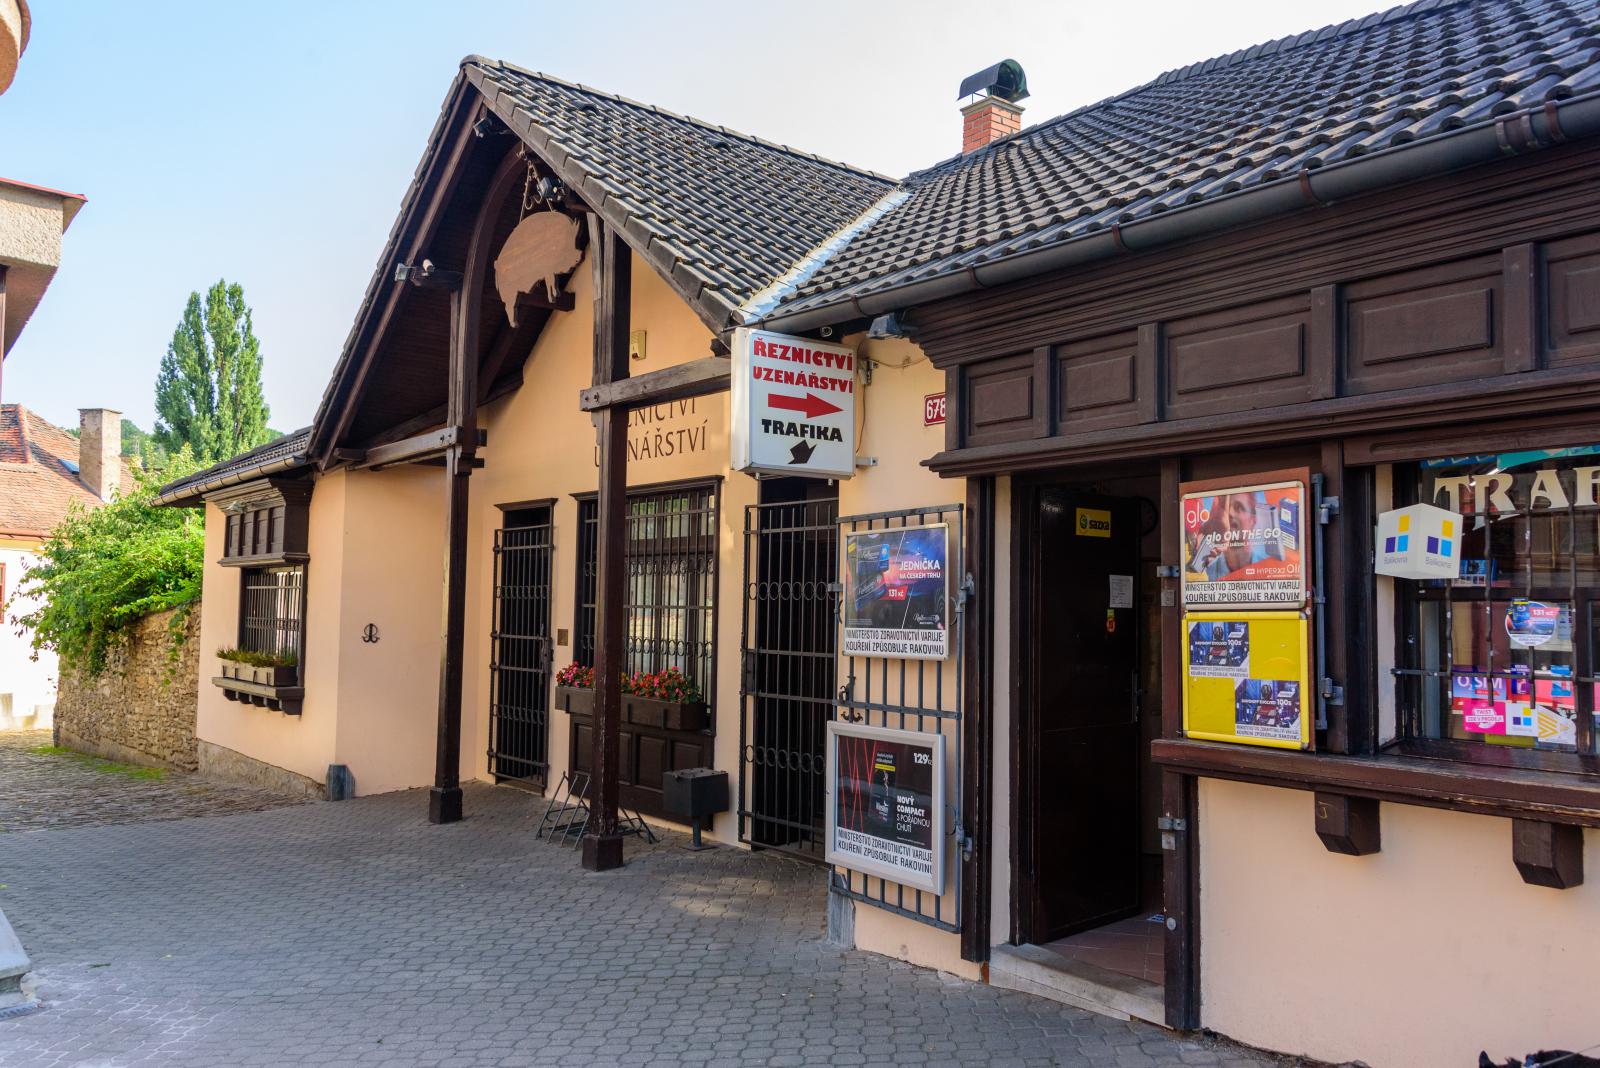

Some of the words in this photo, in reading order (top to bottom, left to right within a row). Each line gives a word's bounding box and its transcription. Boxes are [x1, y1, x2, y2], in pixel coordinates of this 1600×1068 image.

[753, 338, 853, 371] ŘEZNICTVÍ
[753, 365, 853, 394] UZENÁŘSTVÍ
[761, 418, 843, 443] TRAFIKA
[1186, 501, 1210, 528] glo
[1223, 530, 1241, 541] ON
[1241, 528, 1261, 540] THE
[1263, 527, 1281, 538] GO
[899, 558, 941, 571] JEDNIČKA
[897, 795, 915, 806] NOVÝ
[896, 804, 926, 817] COMPACT
